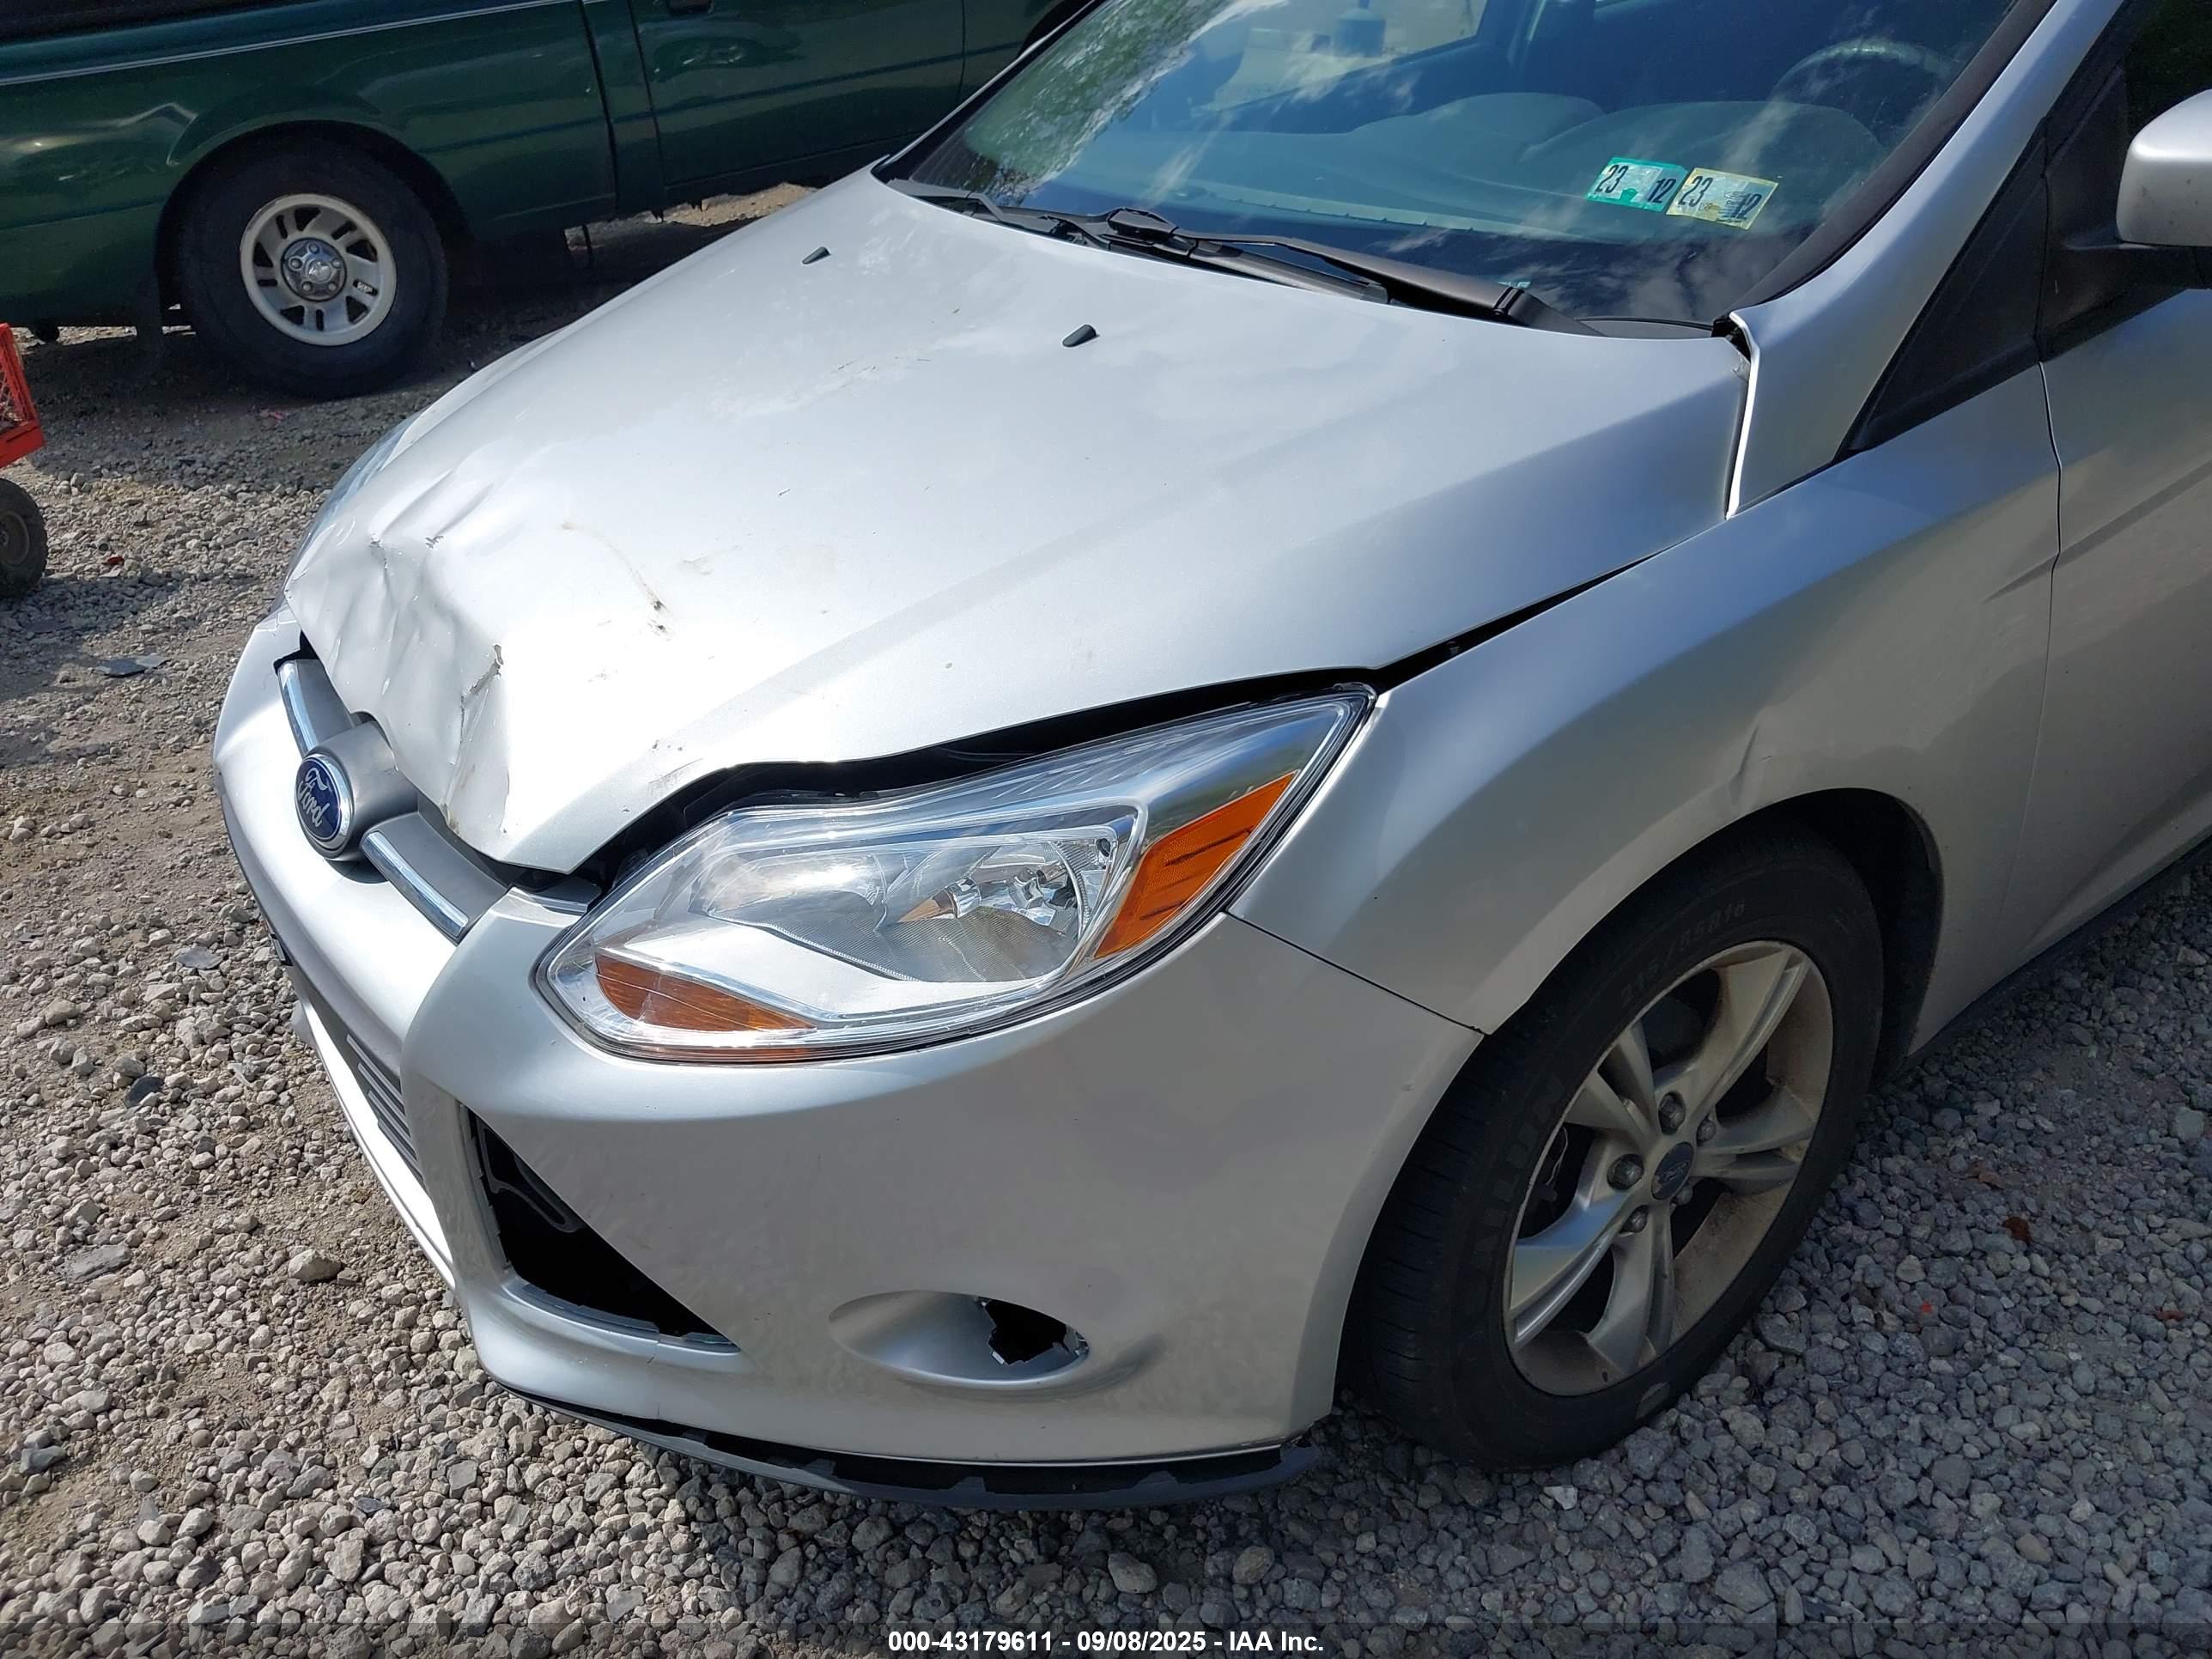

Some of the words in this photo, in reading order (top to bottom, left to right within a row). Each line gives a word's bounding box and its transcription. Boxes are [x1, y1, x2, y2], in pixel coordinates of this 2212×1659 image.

[1595, 164, 1629, 194] 23
[1647, 178, 1677, 204] 12
[1677, 175, 1714, 208] 23
[1732, 192, 1763, 221] 12
[297, 767, 331, 829] Ford
